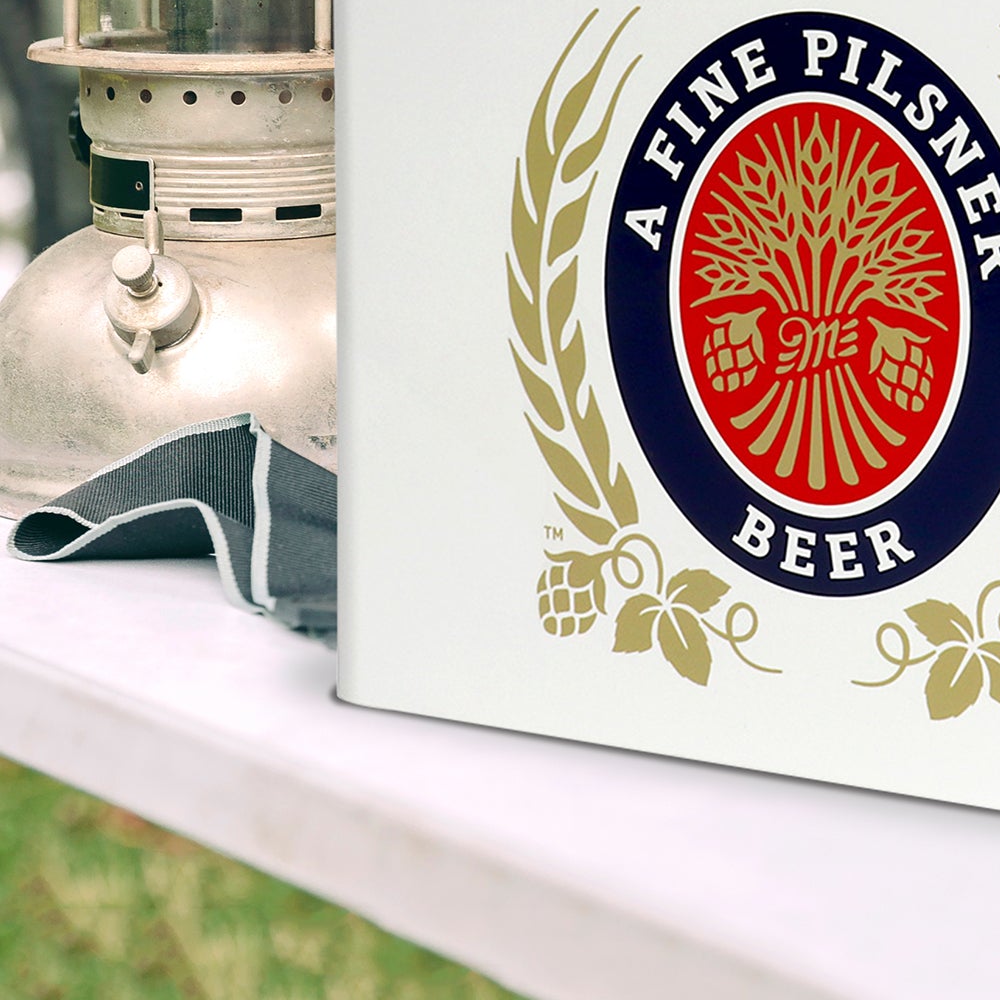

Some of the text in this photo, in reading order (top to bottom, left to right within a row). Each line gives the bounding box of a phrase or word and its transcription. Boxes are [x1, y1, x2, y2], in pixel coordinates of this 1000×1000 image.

[643, 38, 777, 182] FINE
[624, 204, 668, 251] A
[731, 504, 916, 580] BEER
